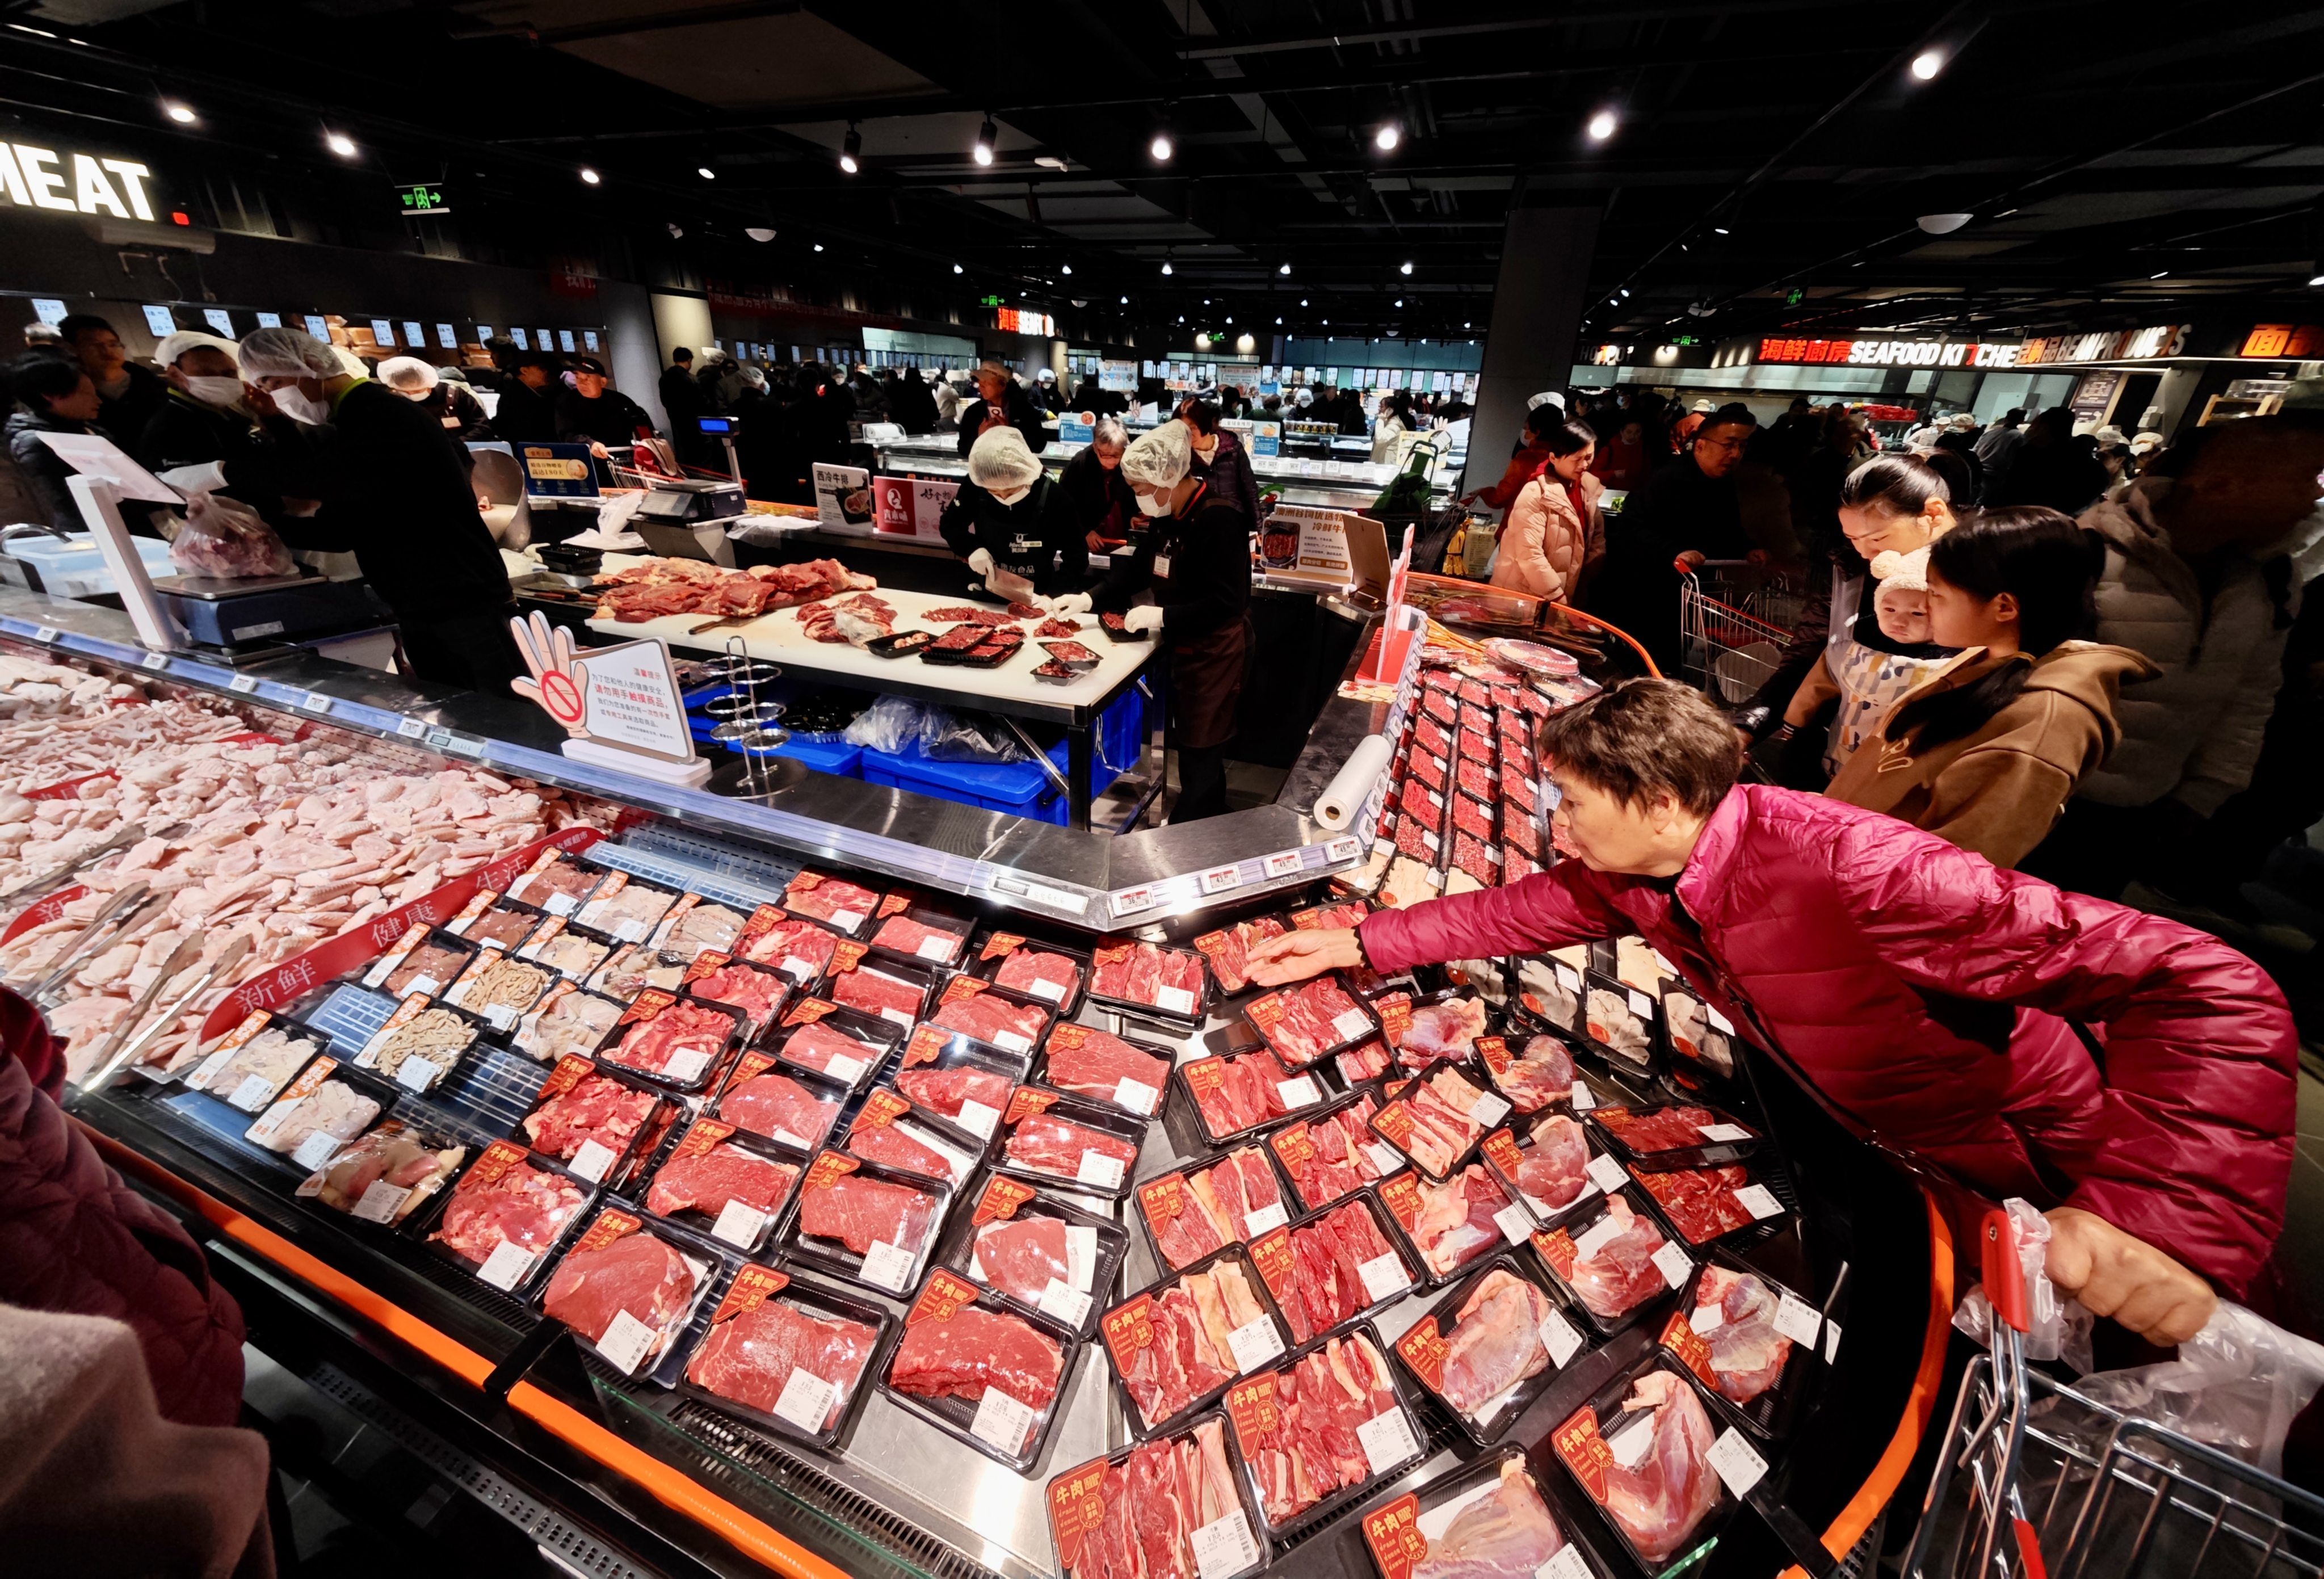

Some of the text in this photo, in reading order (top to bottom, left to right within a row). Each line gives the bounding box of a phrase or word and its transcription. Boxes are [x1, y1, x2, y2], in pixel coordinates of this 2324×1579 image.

[998, 307, 1019, 331] 海鲜
[1759, 339, 2020, 368] 海鲜厨房 SEAFOOD KITCHE
[817, 470, 849, 485] 西冷牛排
[1312, 522, 1346, 534] 冷鲜牛
[633, 667, 662, 681] 温馨提示
[759, 908, 772, 918] 牛肉
[233, 854, 529, 1017] 新鲜 健康 生活
[839, 943, 854, 954] 牛肉
[701, 953, 716, 963] 牛肉
[956, 979, 972, 989] 牛肉
[642, 992, 658, 1004] 牛肉
[806, 1002, 820, 1012] 牛肉
[1254, 1000, 1268, 1014] 牛肉
[1384, 1007, 1398, 1018] 牛肉
[919, 1030, 936, 1042] 牛肉
[1061, 1026, 1077, 1035] 牛肉
[562, 1058, 579, 1072] 牛肉
[745, 1056, 761, 1069] 牛肉
[1191, 1065, 1209, 1076] 牛肉
[874, 1094, 892, 1109] 牛肉
[1019, 1091, 1039, 1103] 牛肉
[1379, 1111, 1396, 1127] 牛肉
[696, 1123, 715, 1135] 牛肉
[1277, 1135, 1297, 1150] 牛肉
[1487, 1139, 1505, 1152] 牛肉
[491, 1146, 509, 1161] 牛肉
[819, 1156, 839, 1169] 牛肉
[993, 1182, 1014, 1196] 牛肉
[1146, 1186, 1167, 1201] 牛肉
[1385, 1184, 1402, 1198] 牛肉
[602, 1213, 621, 1230] 牛肉
[1254, 1242, 1275, 1260] 牛肉
[742, 1270, 765, 1287] 牛肉
[932, 1278, 956, 1297] 牛肉
[1111, 1312, 1134, 1333] 牛肉
[1405, 1334, 1427, 1355] 牛肉
[1234, 1386, 1258, 1408] 牛肉
[1561, 1429, 1586, 1452] 牛肉
[1057, 1479, 1084, 1505] 牛肉
[1372, 1513, 1400, 1538] 牛肉
